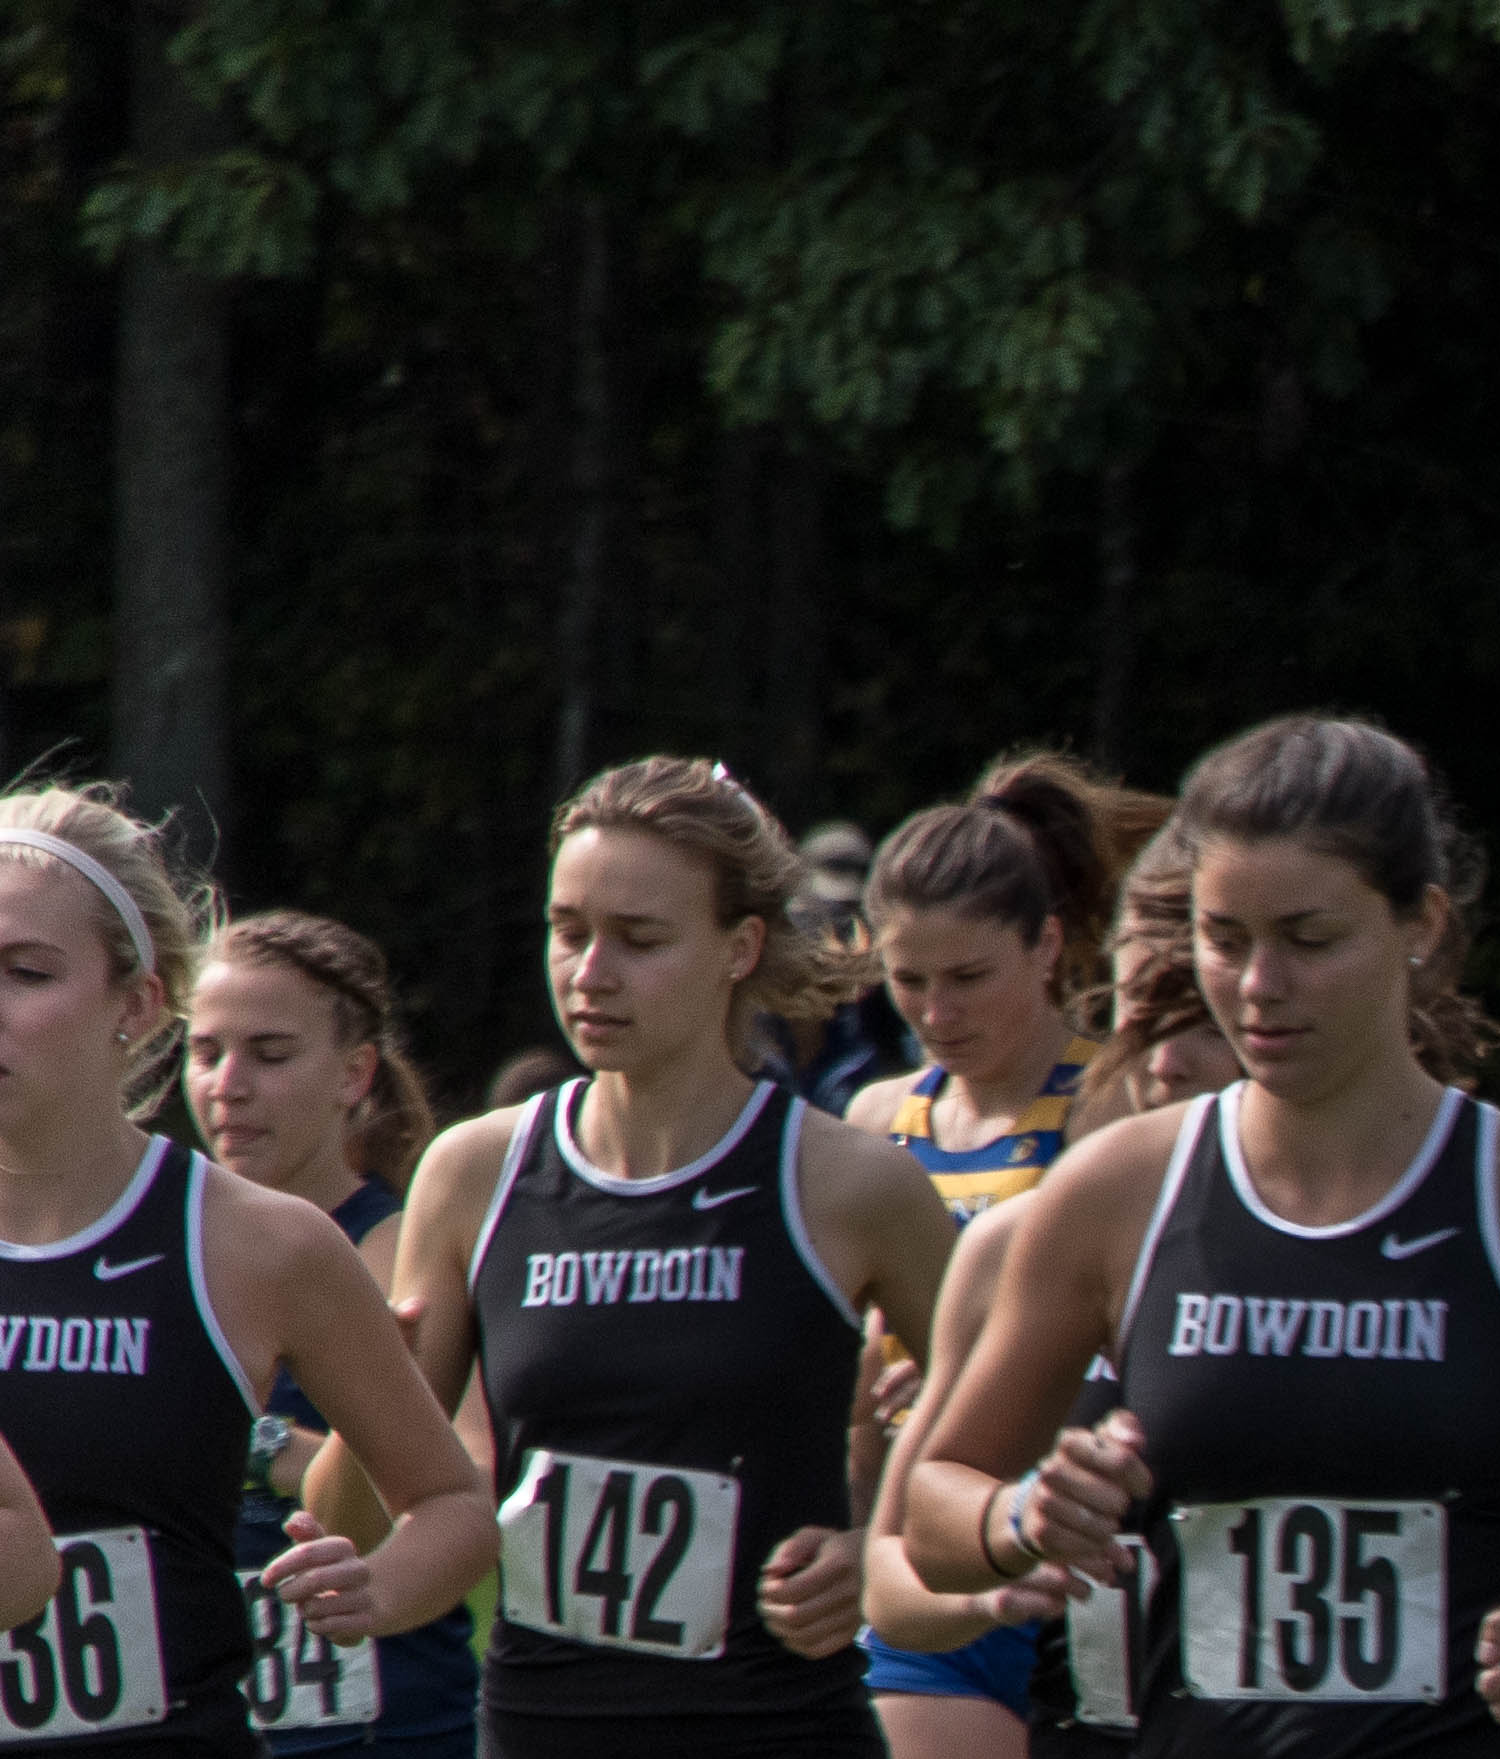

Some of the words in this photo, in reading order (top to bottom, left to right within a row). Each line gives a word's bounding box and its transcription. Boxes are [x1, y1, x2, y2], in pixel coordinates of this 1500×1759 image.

[521, 1246, 744, 1308] BOWDOIN
[1169, 1293, 1447, 1362] BOWDOIN
[534, 1464, 697, 1646] 142
[1228, 1503, 1404, 1692] 135
